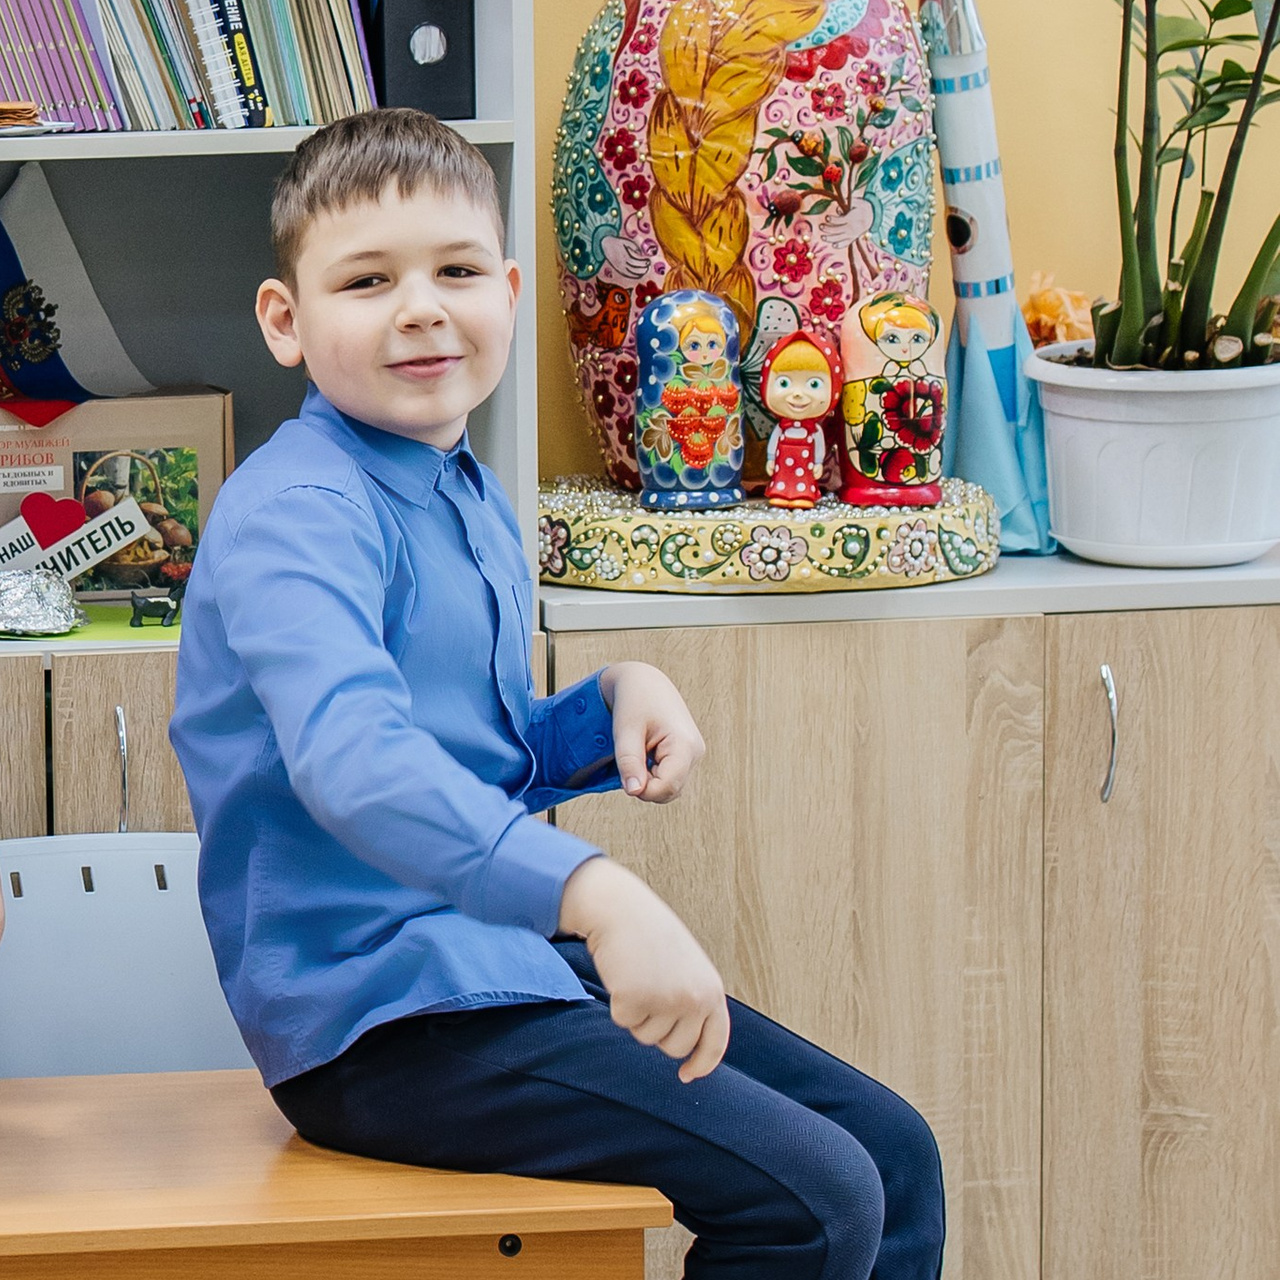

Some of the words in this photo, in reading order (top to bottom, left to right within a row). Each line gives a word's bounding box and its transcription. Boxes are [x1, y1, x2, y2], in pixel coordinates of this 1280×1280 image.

[16, 437, 70, 450] МУЛЯЖЕЙ
[2, 479, 47, 487] ЯДОВИТЫХ
[31, 516, 135, 577] ЧИТЕЛЬ
